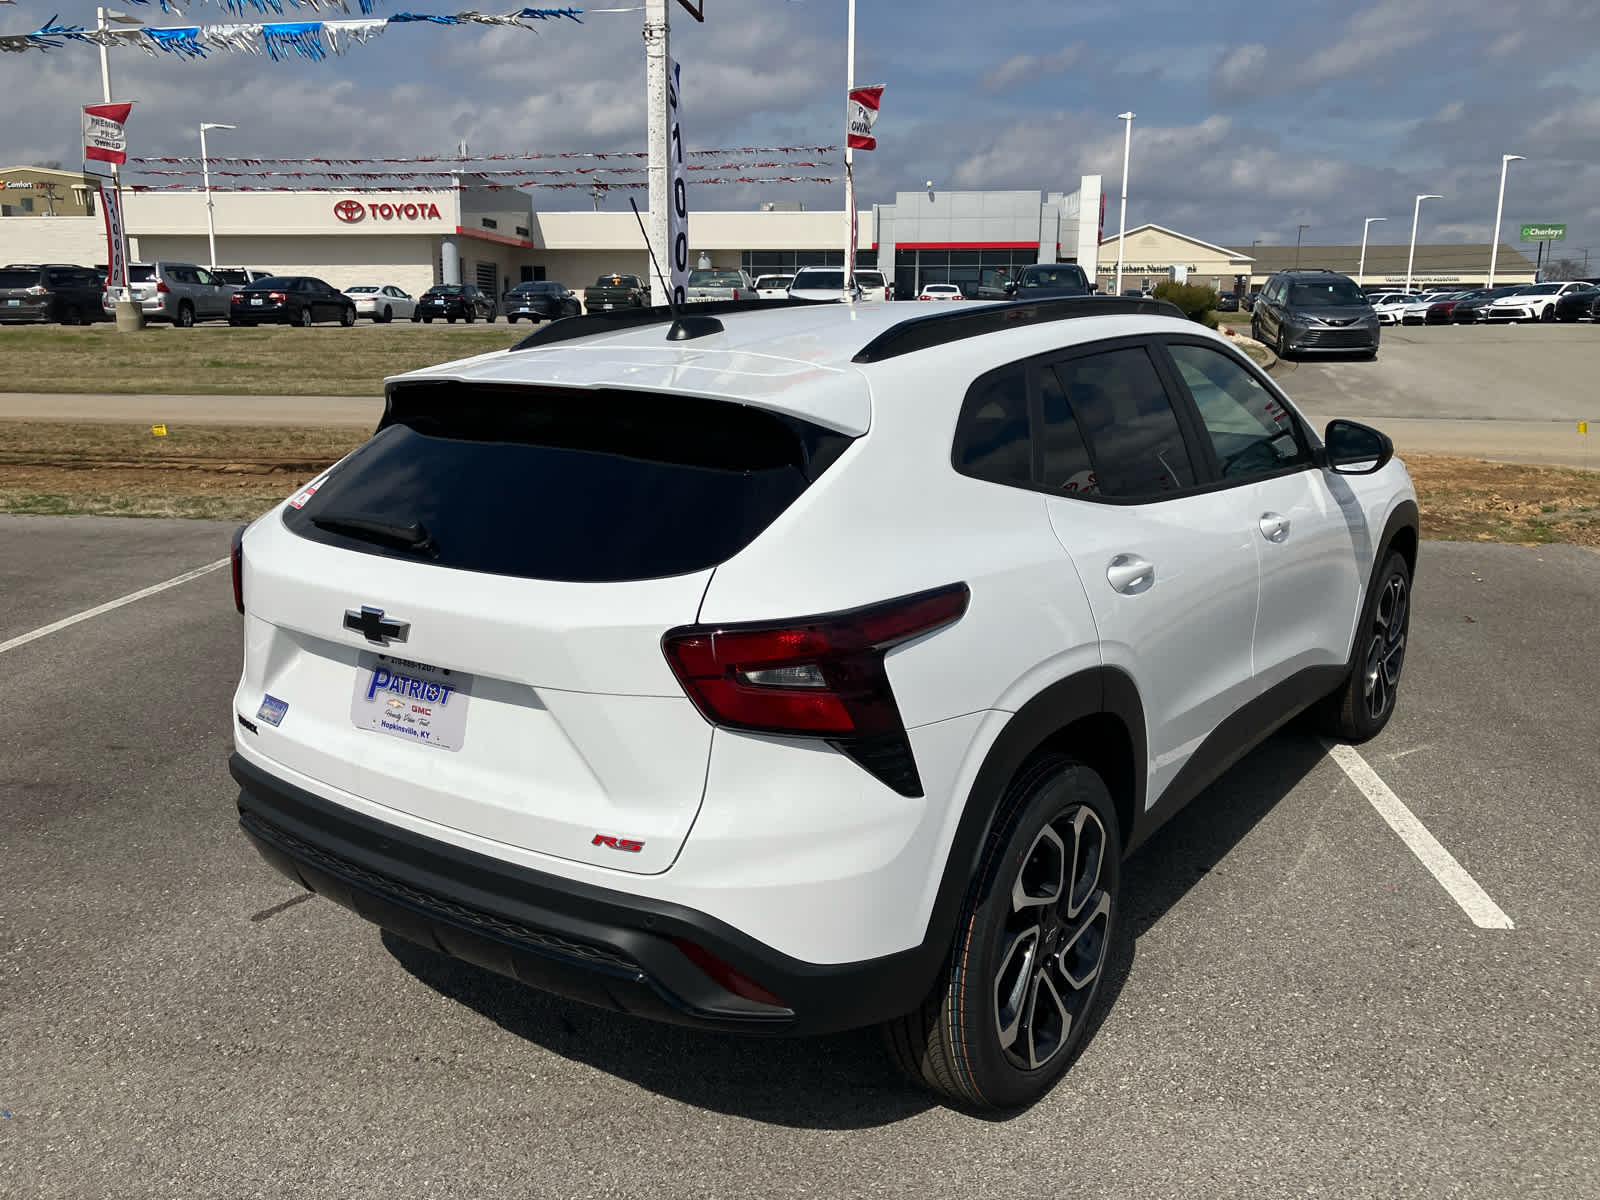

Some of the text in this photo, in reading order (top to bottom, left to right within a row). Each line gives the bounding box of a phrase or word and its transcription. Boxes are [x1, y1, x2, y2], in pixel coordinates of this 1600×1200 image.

[94, 139, 121, 149] OWNED
[367, 203, 441, 219] TOYOTA
[366, 666, 455, 705] PATRIOT
[411, 704, 432, 716] GMC
[380, 719, 431, 739] Hopkinsville, KY
[591, 833, 646, 853] RS
